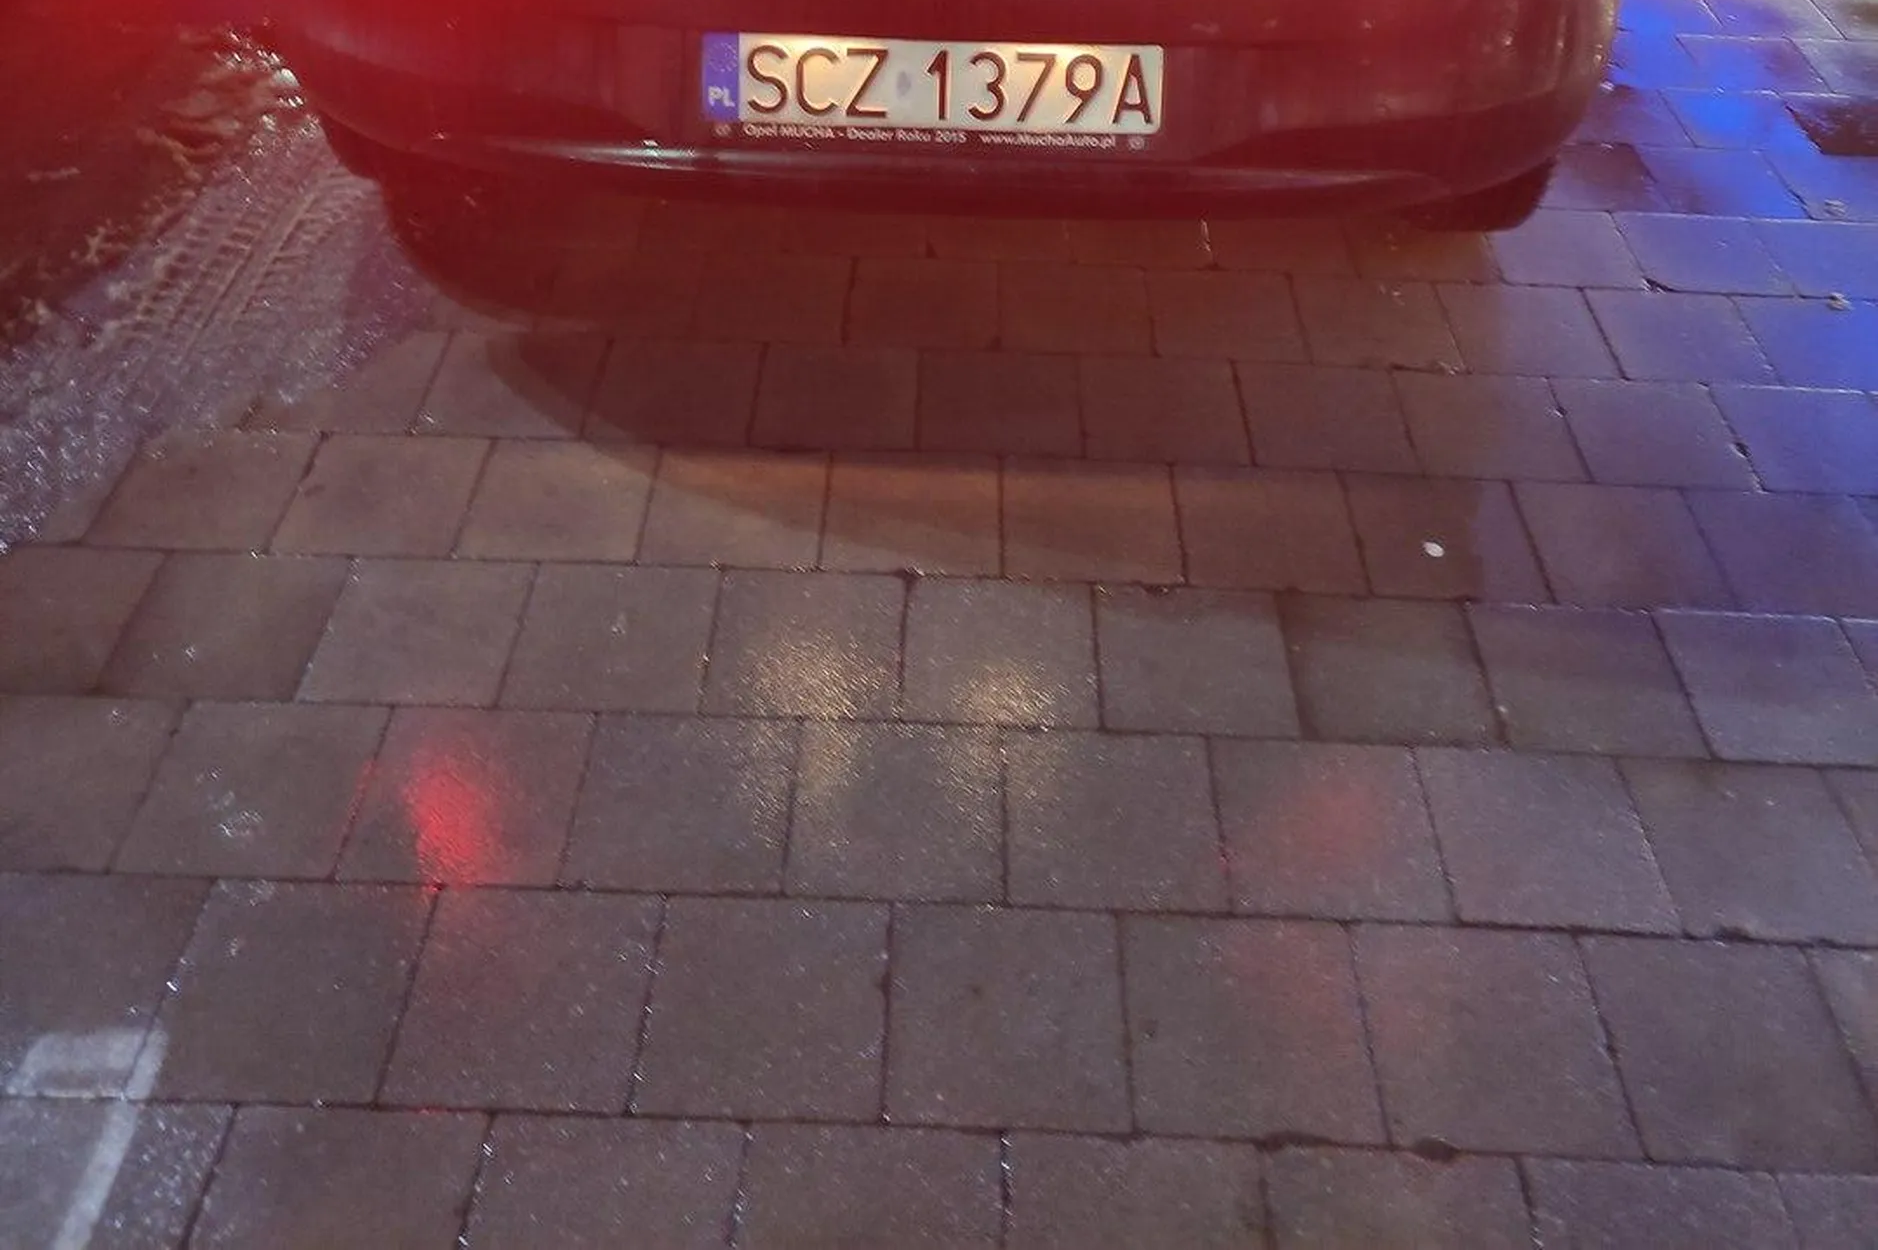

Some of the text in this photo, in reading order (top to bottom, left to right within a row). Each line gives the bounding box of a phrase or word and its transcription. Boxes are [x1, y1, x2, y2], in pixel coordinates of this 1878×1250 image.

[747, 44, 1153, 124] SCZ 1379A
[707, 86, 736, 108] PL
[742, 122, 777, 139] Opel
[781, 124, 835, 139] MUCHA
[848, 128, 893, 141] Dealer
[897, 129, 931, 142] Roku
